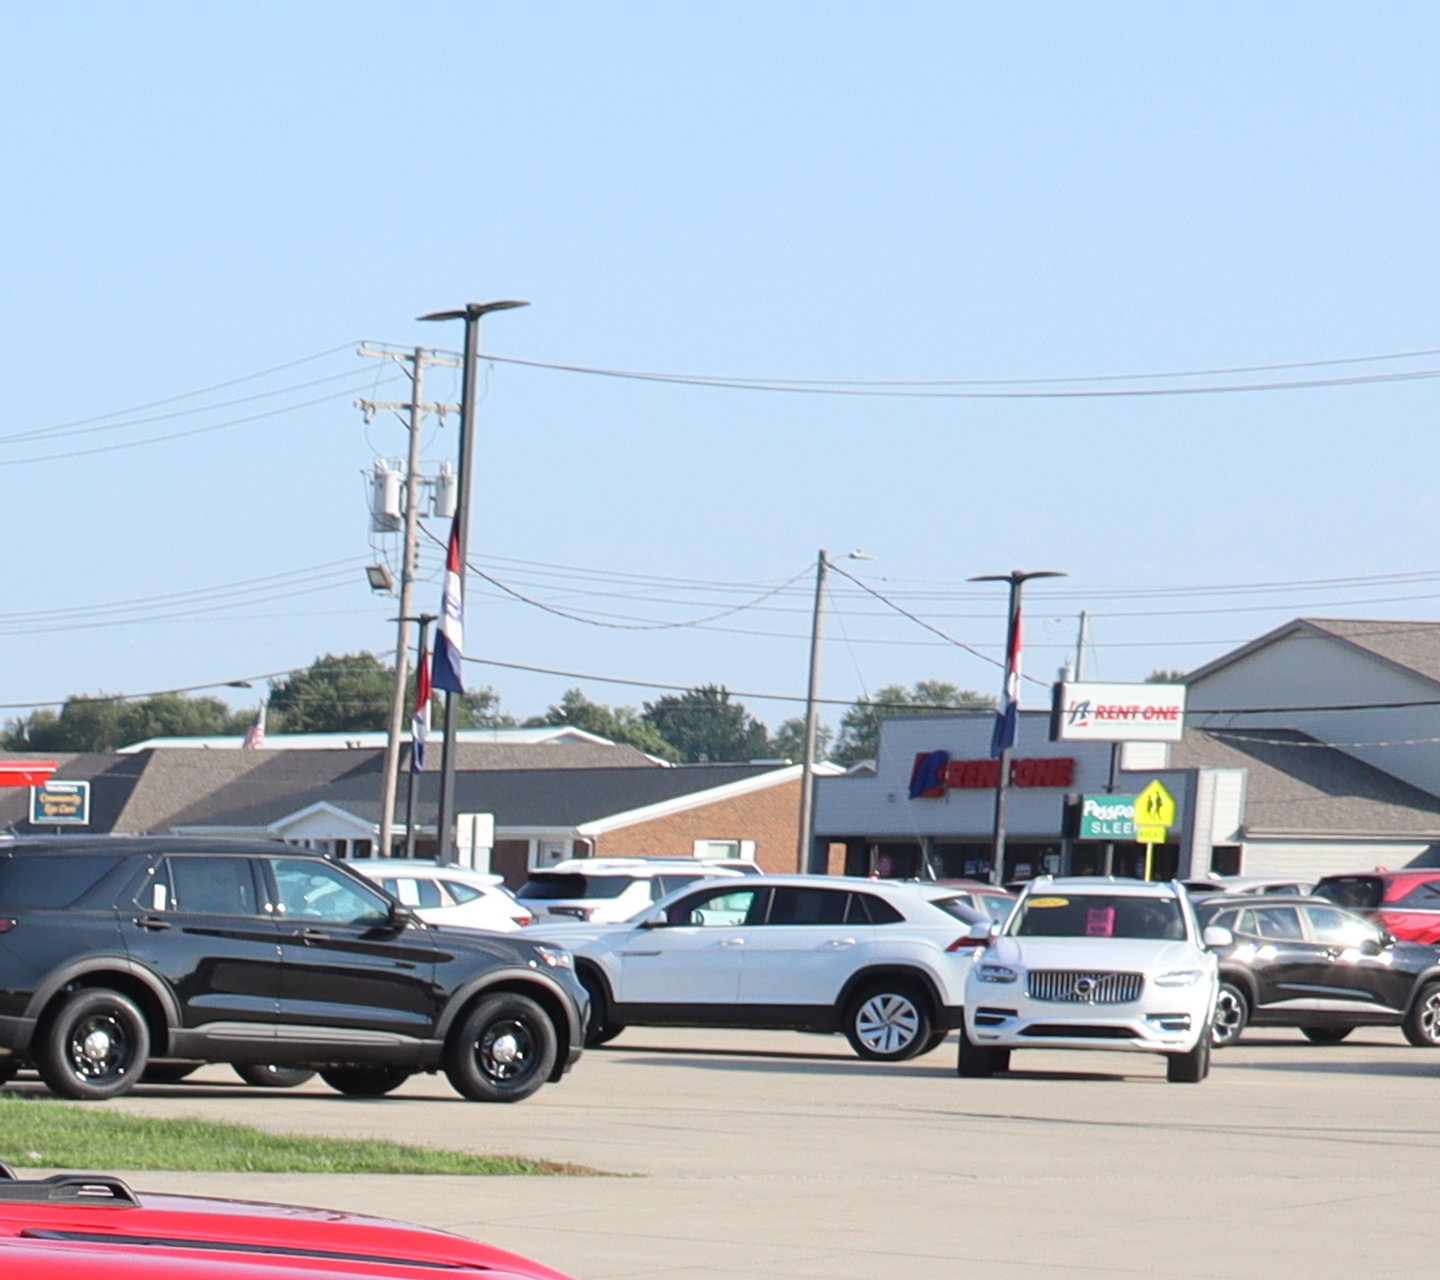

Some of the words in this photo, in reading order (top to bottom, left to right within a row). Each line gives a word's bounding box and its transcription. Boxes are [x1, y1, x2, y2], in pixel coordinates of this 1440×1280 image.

[1094, 704, 1140, 720] RENT
[1142, 704, 1180, 721] ONE
[1083, 799, 1136, 821] Passpo
